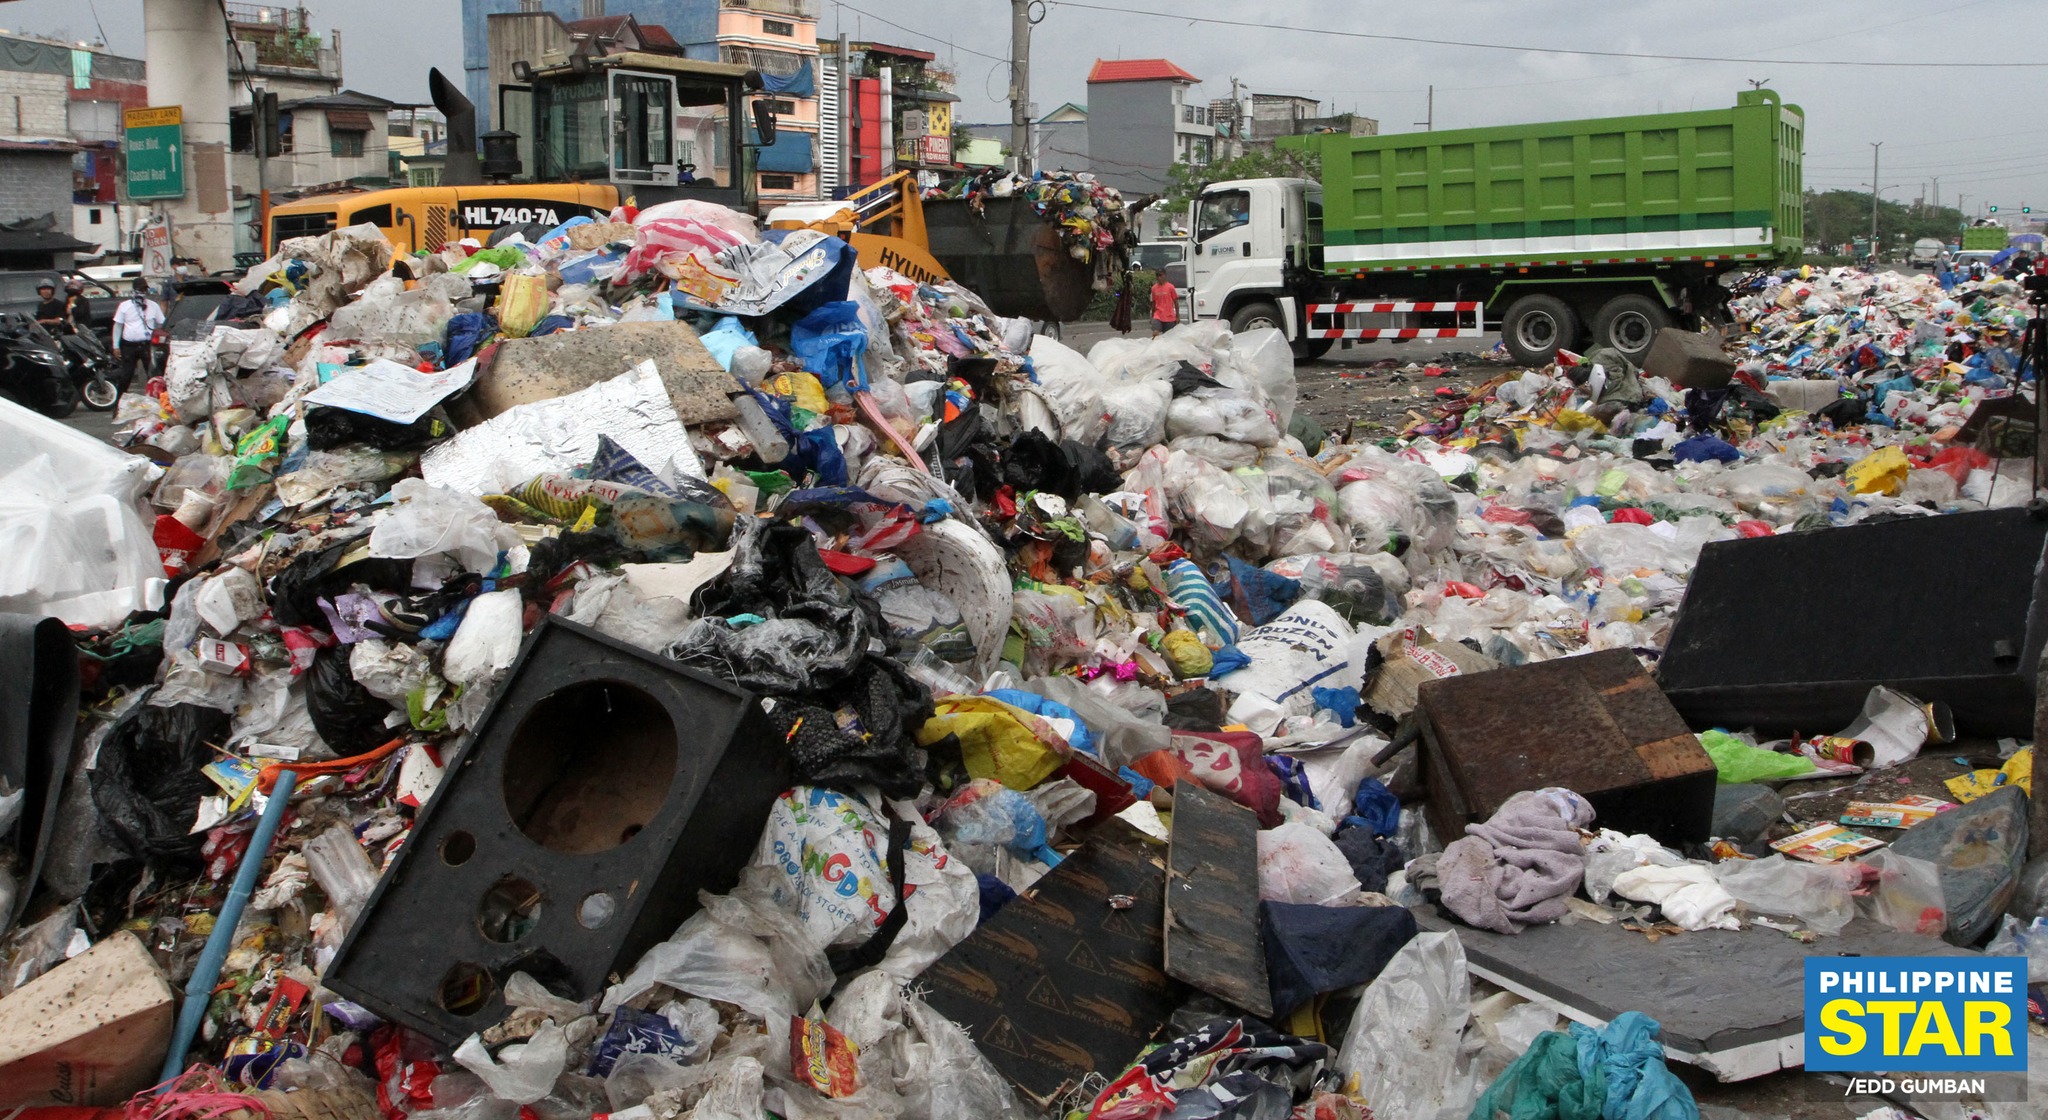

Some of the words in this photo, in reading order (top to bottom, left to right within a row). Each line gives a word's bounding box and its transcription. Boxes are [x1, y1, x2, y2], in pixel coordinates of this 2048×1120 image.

[554, 82, 608, 99] HYUNDAI
[160, 109, 177, 118] LANE
[465, 206, 560, 226] HL740-7A
